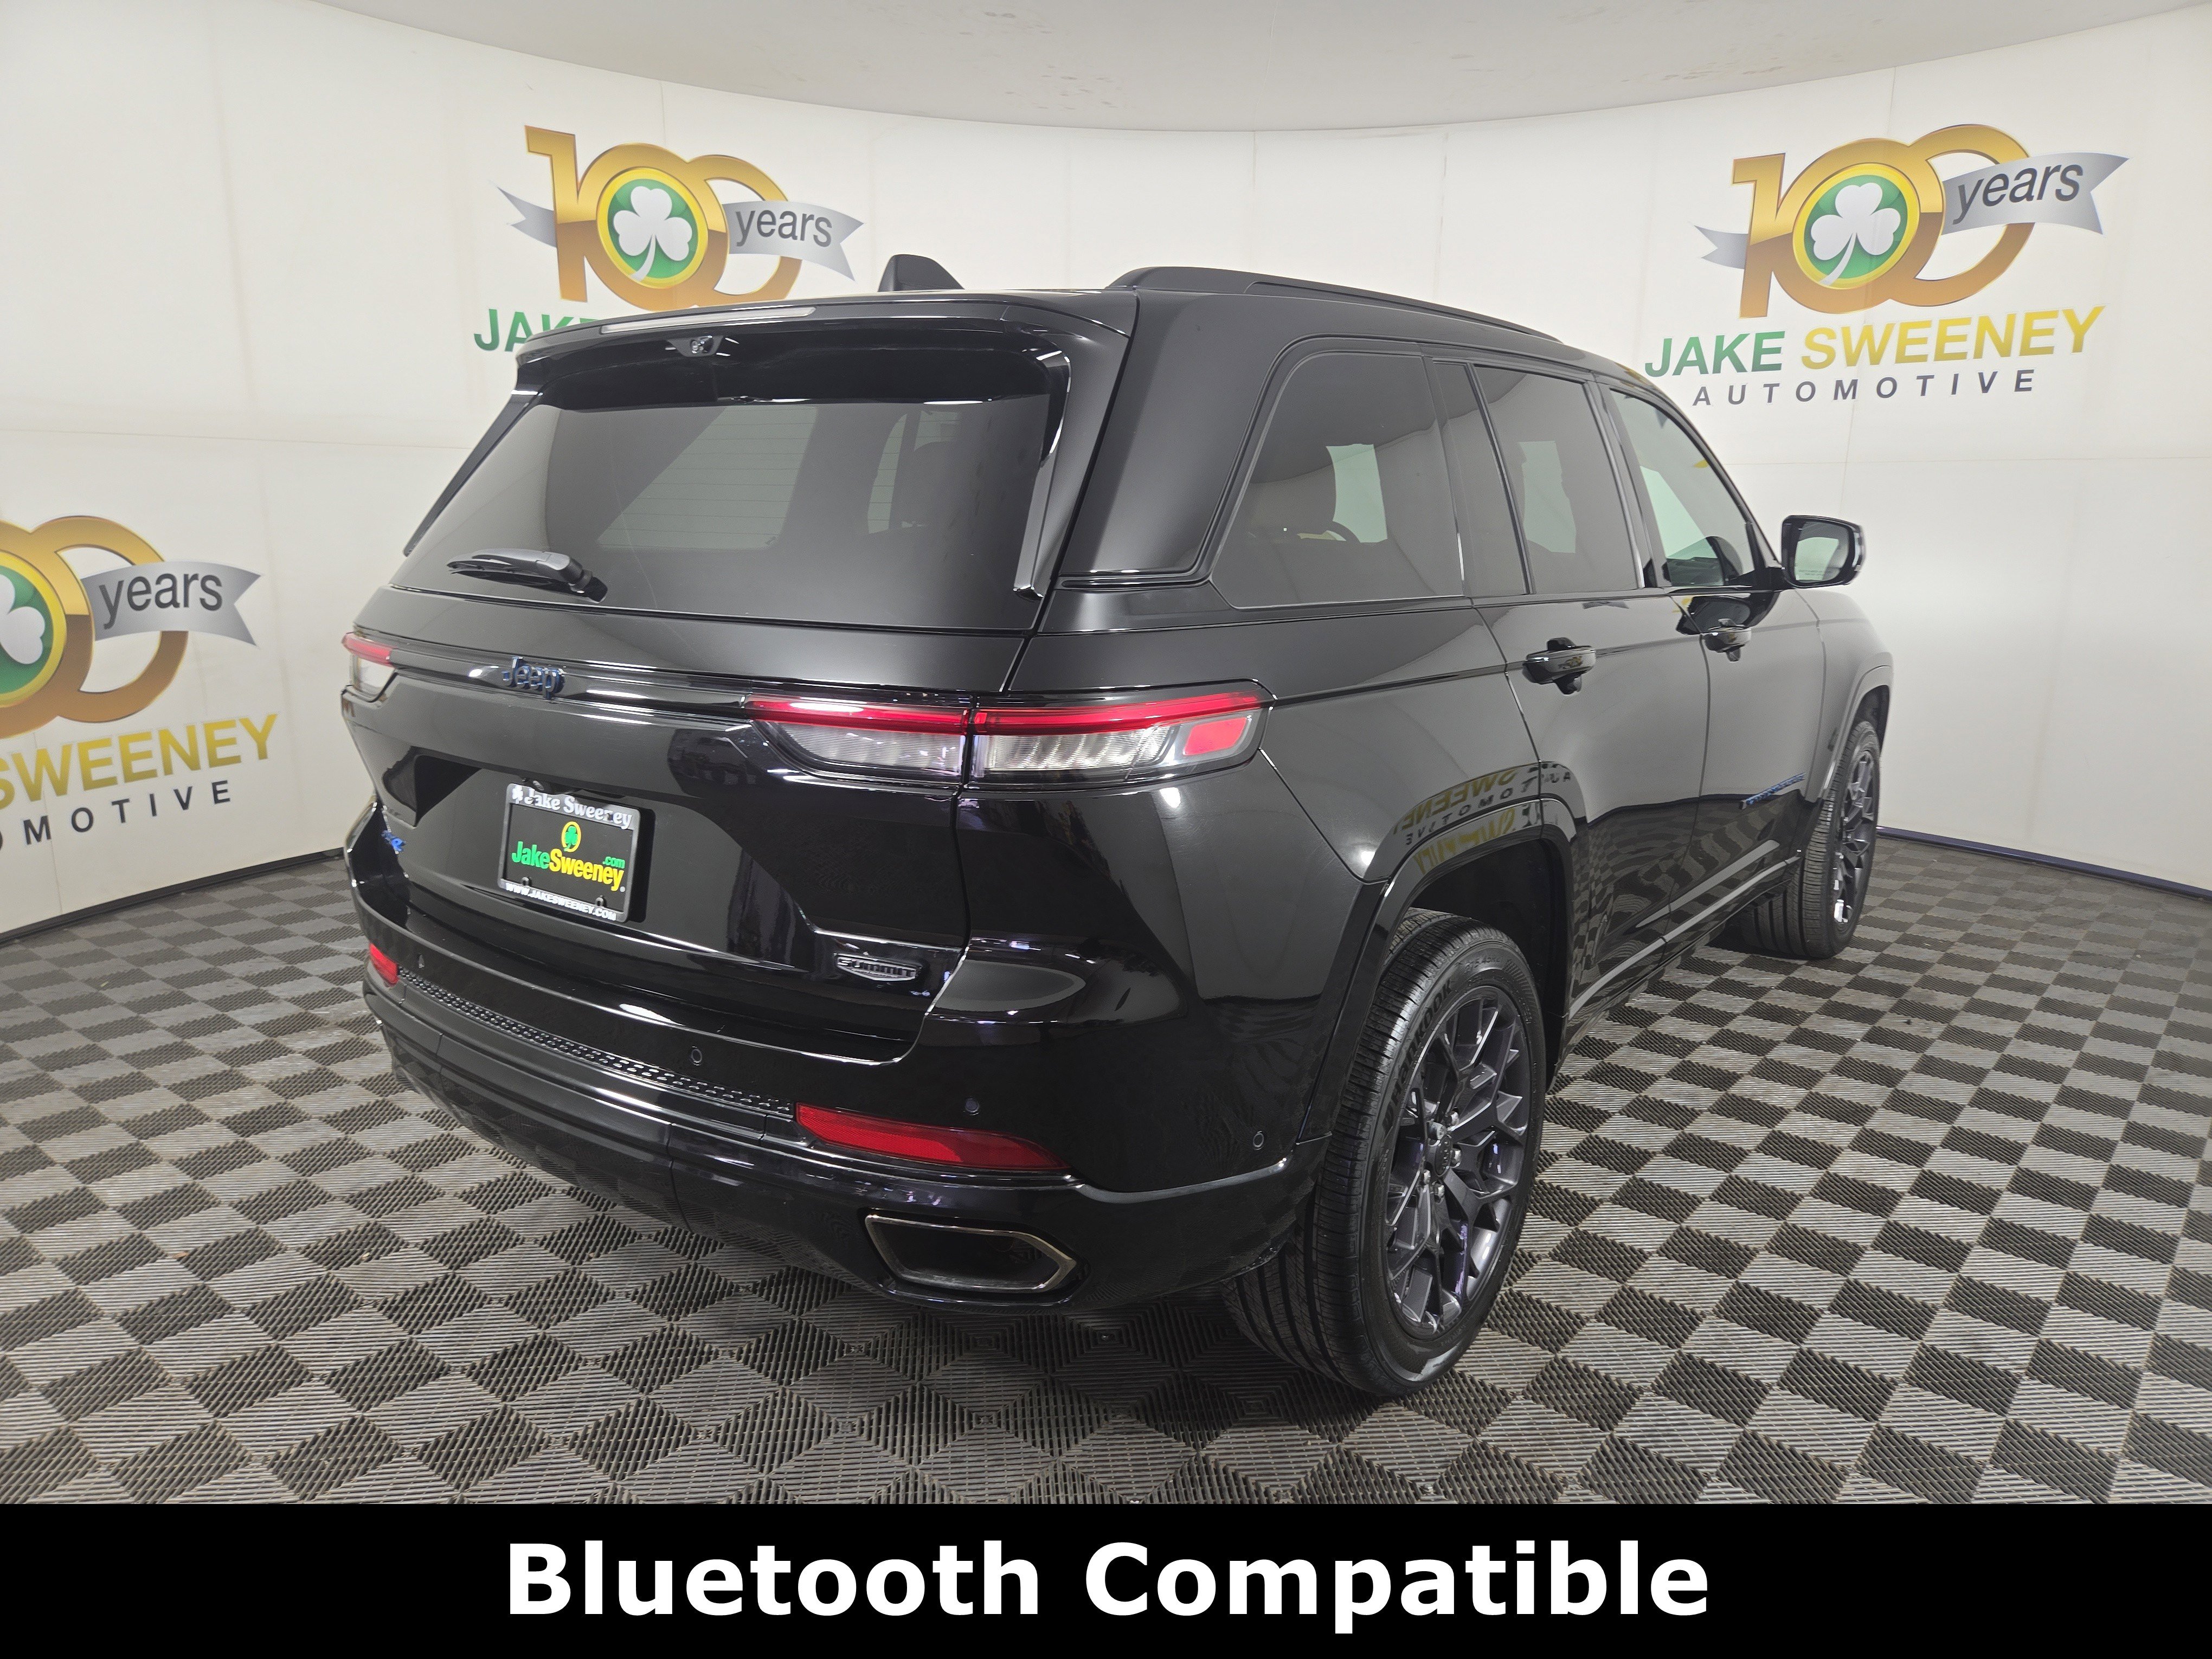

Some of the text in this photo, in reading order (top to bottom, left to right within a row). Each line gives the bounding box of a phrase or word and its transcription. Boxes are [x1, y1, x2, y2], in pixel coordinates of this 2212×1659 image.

[1952, 163, 2084, 224] years
[735, 209, 833, 247] years
[1645, 305, 2107, 377] JAKE SWEENEY
[1693, 369, 2035, 407] AUTOMOTIVE
[99, 573, 223, 630] years
[501, 656, 562, 700] Jeep
[0, 713, 278, 811] WEENEY
[505, 882, 617, 921] WWW.JAKESWEENEY.COM
